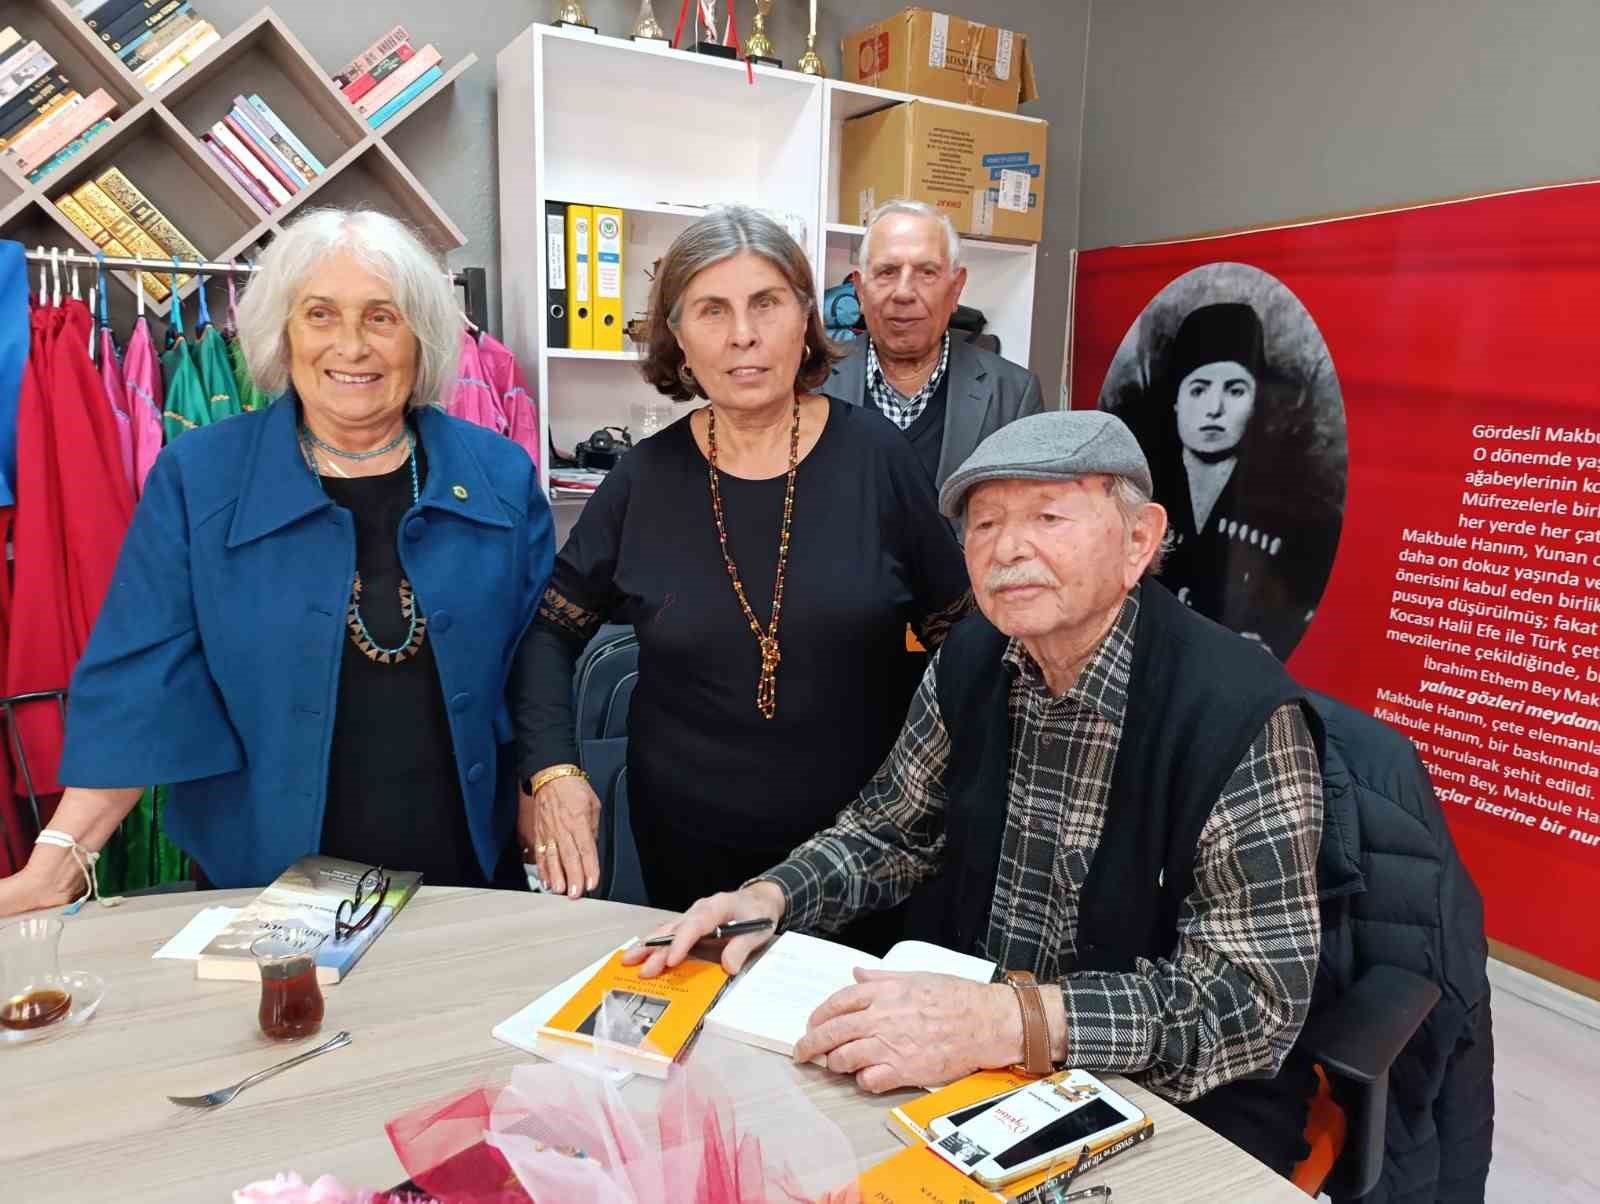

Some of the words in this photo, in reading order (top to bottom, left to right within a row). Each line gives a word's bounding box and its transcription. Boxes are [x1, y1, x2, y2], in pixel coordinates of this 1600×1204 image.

[1472, 424, 1540, 441] Gördesli
[1474, 447, 1486, 461] O
[1491, 449, 1572, 467] dönemde
[1465, 470, 1577, 492] ağabeylerinin
[1462, 492, 1567, 514] Müfrezelerle
[1458, 514, 1485, 529] her
[1489, 520, 1536, 535] yerde
[1540, 523, 1570, 539] her
[1402, 528, 1467, 548] Makbule
[1471, 537, 1528, 558] Hanım,
[1534, 544, 1587, 564] Yunan
[1396, 568, 1459, 589] önerisini
[1463, 578, 1506, 597] kabul
[1511, 588, 1553, 604] eden
[1399, 549, 1434, 564] daha
[1438, 557, 1458, 568] on
[1462, 558, 1510, 576] dokuz
[1515, 565, 1579, 586] yaşında
[1390, 608, 1434, 627] Kocası
[1438, 617, 1473, 633] Halil
[1477, 624, 1500, 640] Efe
[1505, 629, 1525, 644] ile
[1530, 633, 1567, 652] Türk
[1392, 590, 1443, 610] pusuya
[1448, 598, 1548, 629] düşürülmüş;
[1554, 615, 1598, 636] fakat
[1387, 629, 1471, 656] mevzilerine
[1475, 647, 1579, 680] çekildiğinde,
[1419, 679, 1464, 699] yalnız
[1467, 691, 1525, 713] gözleri
[1424, 655, 1477, 680] İbrahim
[1480, 670, 1528, 691] Ethem
[1532, 681, 1561, 700] Bey
[1377, 688, 1433, 712] Makbule
[1437, 703, 1487, 728] Hanım,
[1492, 719, 1524, 735] çete
[1374, 707, 1430, 732] Makbule
[1434, 723, 1483, 748] Hanım,
[1488, 737, 1509, 753] bir
[1513, 744, 1599, 778] baskınında
[1433, 744, 1500, 772] vurularak
[1503, 767, 1542, 785] şehit
[1546, 779, 1595, 799] edildi.
[1469, 776, 1498, 795] Bey,
[1503, 785, 1572, 815] Makbule
[1474, 797, 1536, 826] üzerine
[1540, 818, 1566, 835] bir
